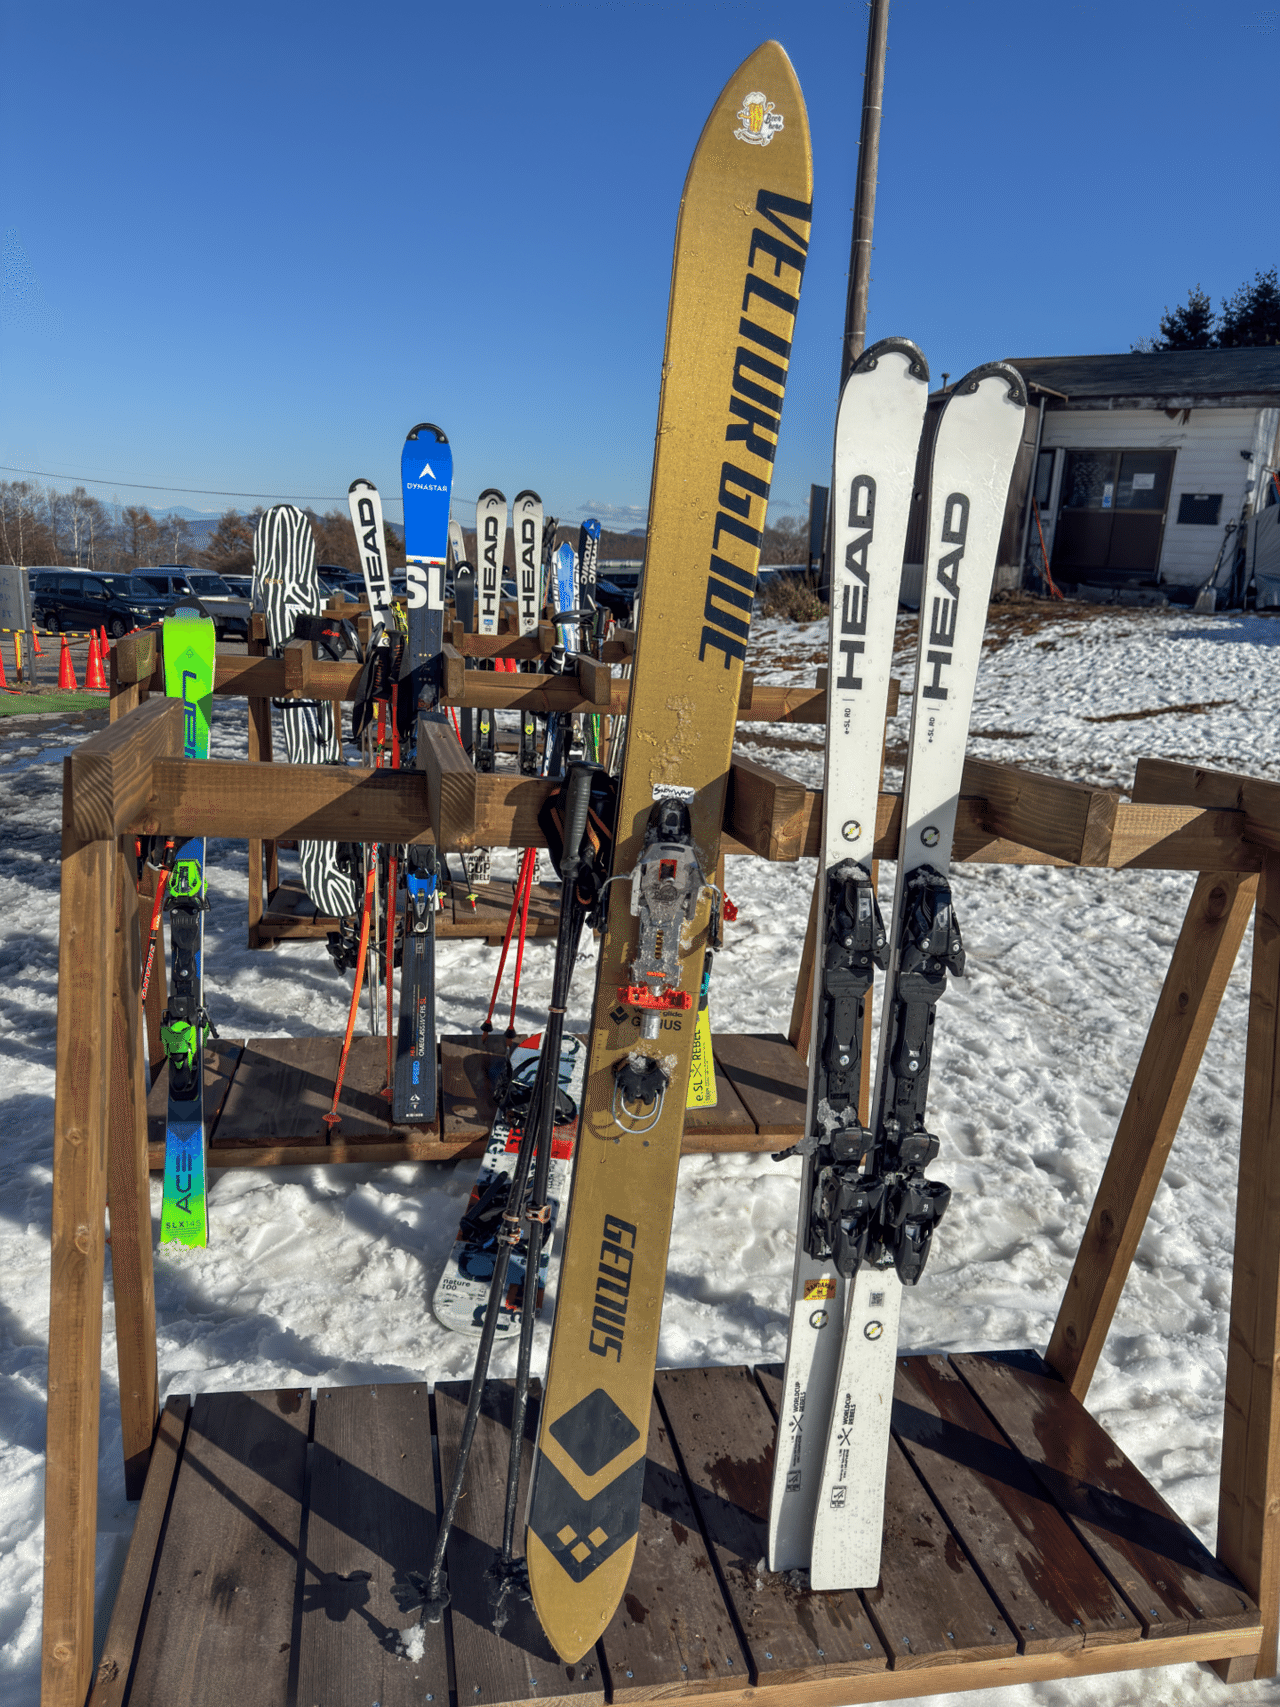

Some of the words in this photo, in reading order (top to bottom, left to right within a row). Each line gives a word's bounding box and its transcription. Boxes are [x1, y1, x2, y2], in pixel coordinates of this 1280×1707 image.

[406, 483, 448, 492] DYNASTAR
[358, 497, 390, 611] HEAD
[483, 516, 498, 615] HEAD
[522, 519, 535, 617] HEAD
[580, 534, 593, 585] ATOMIC
[406, 565, 445, 611] SL
[837, 474, 876, 690] HEAD
[922, 491, 971, 700] HEAD
[467, 862, 490, 873] CUP
[631, 1016, 682, 1031] GIUS
[175, 1150, 193, 1215] ACE
[441, 1283, 457, 1291] 100
[443, 1277, 471, 1288] nature
[588, 1213, 638, 1363] GENIUS
[792, 1381, 801, 1413] WORLDCUP
[842, 1393, 852, 1425] WORLDCUP
